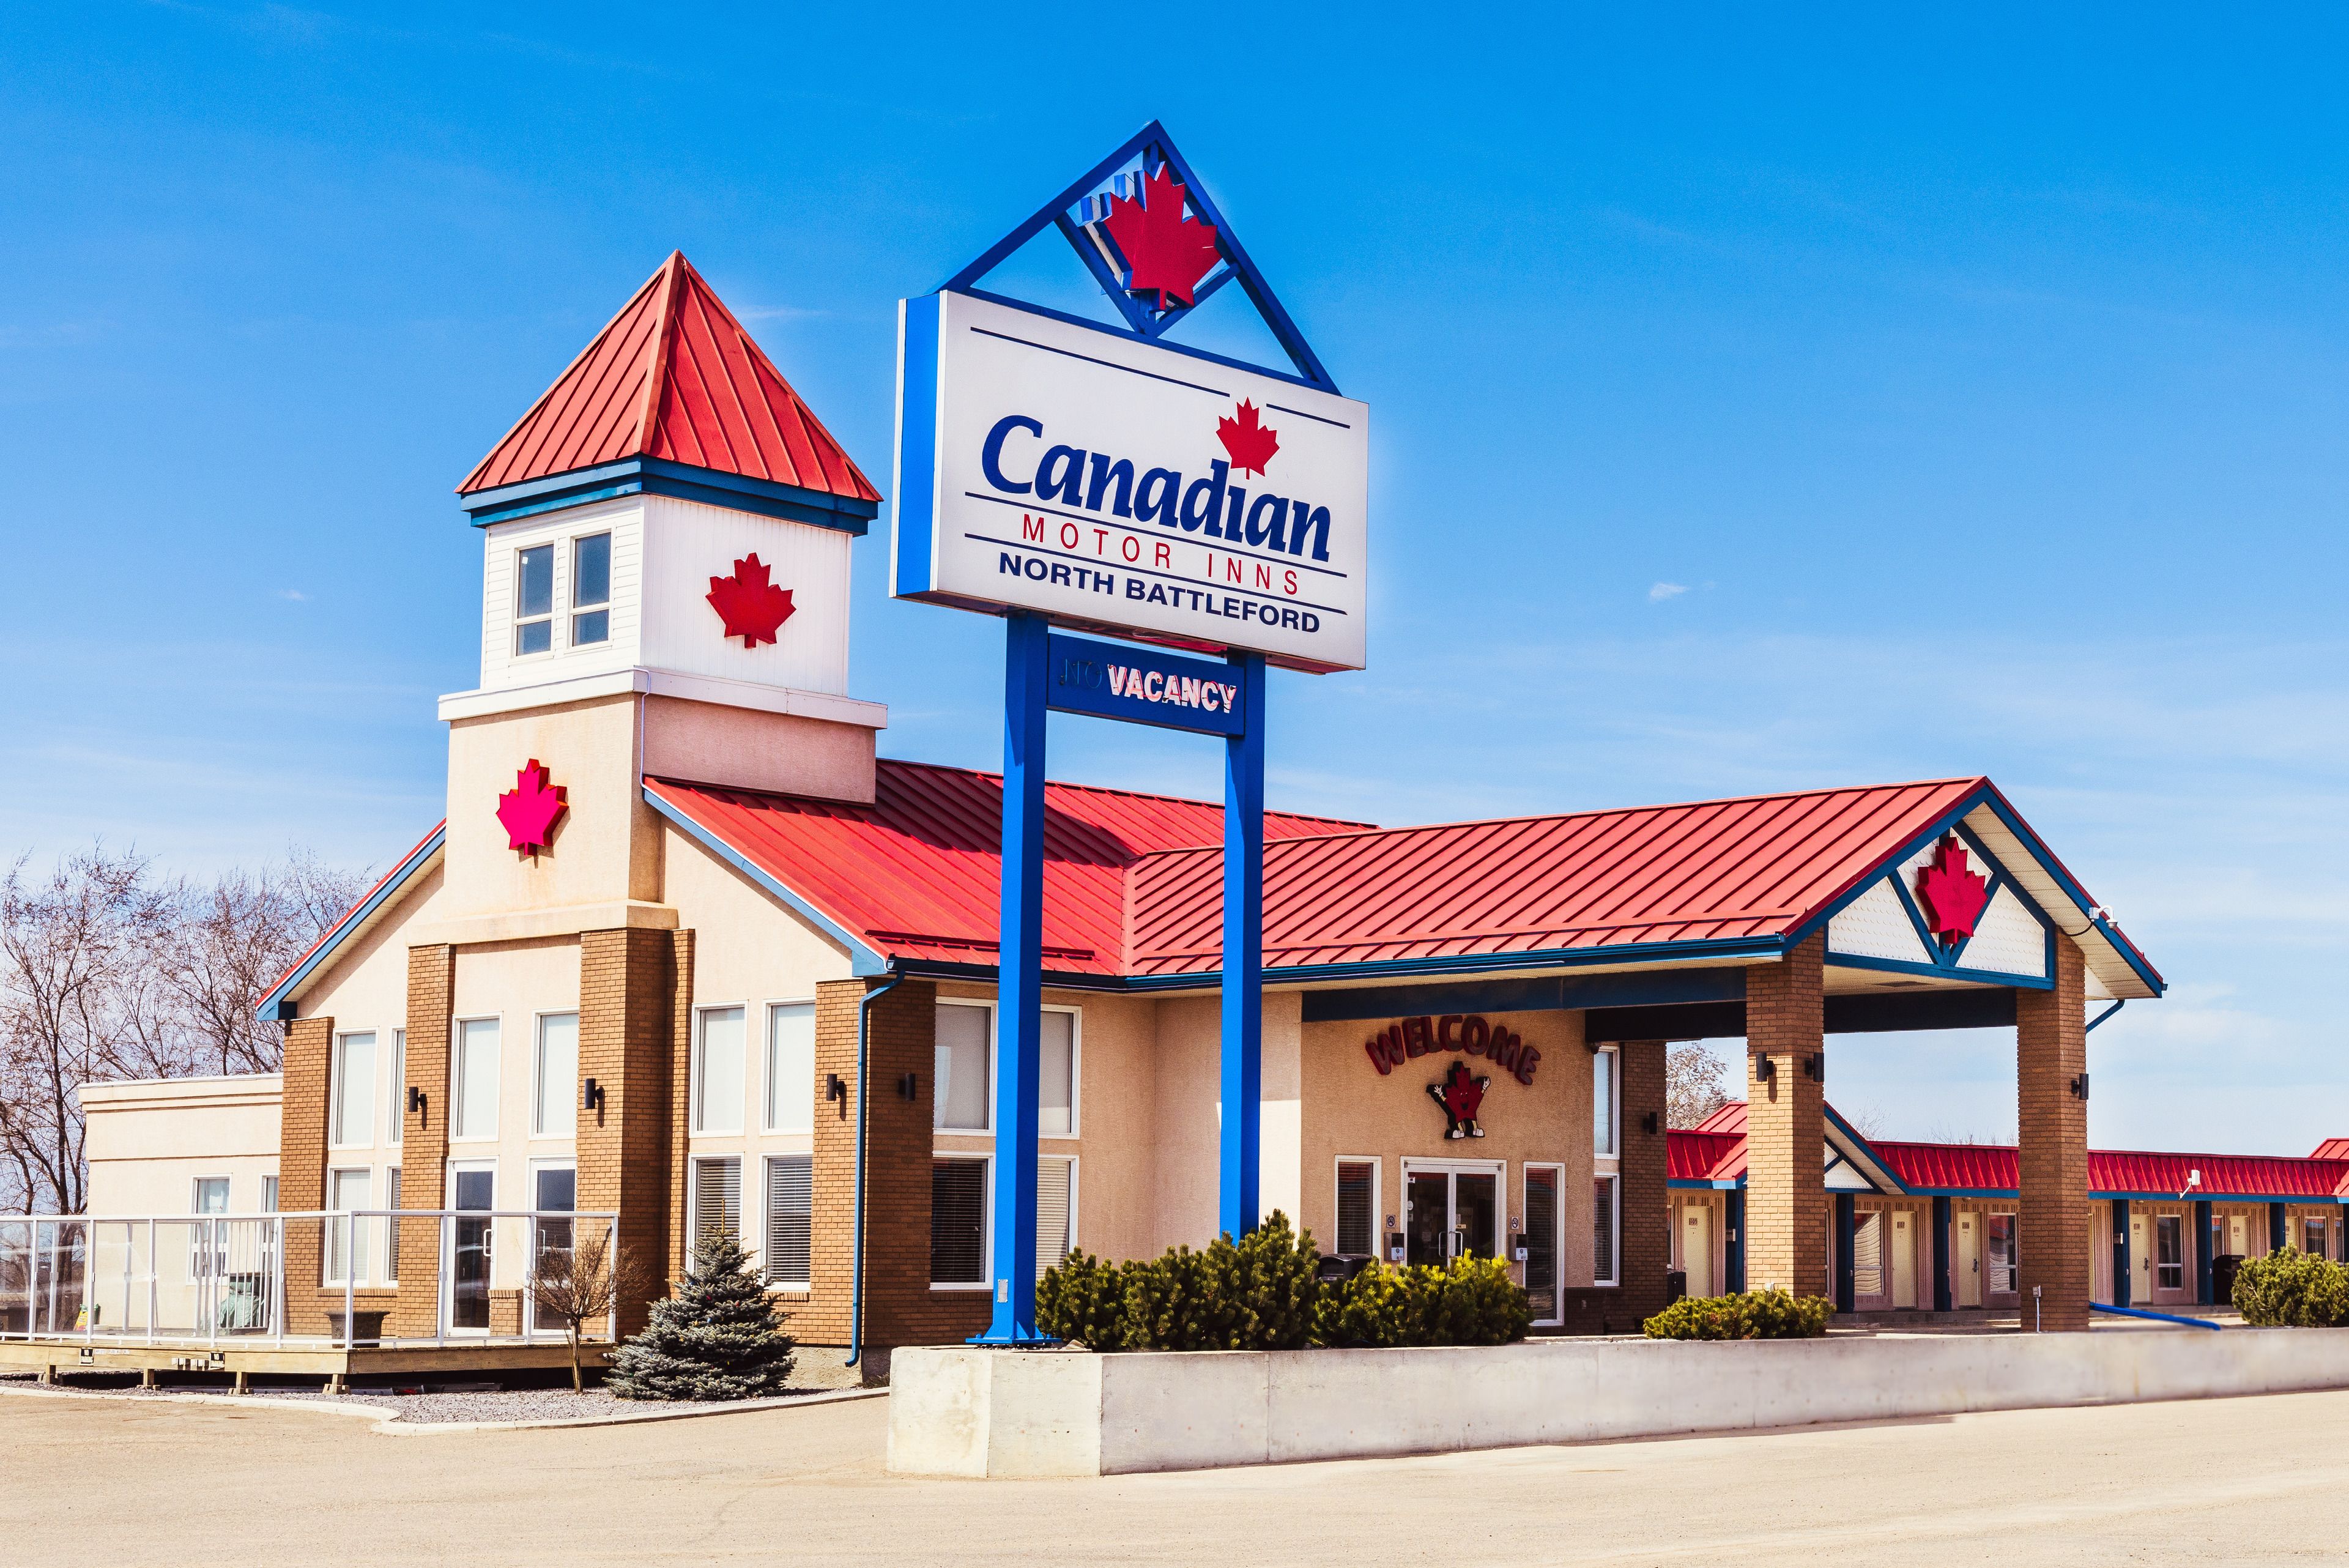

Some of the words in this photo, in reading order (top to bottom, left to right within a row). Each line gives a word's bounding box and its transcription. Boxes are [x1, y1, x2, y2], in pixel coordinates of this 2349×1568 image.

[982, 415, 1330, 563] Canadian
[999, 552, 1114, 595] NORTH
[1126, 578, 1319, 633] BATTLEFORD
[1023, 513, 1170, 568] MOTOR
[1208, 553, 1297, 595] INNS
[1060, 658, 1102, 689] NO
[1107, 663, 1236, 714] VACANCY
[1365, 1014, 1542, 1085] WELCOME
